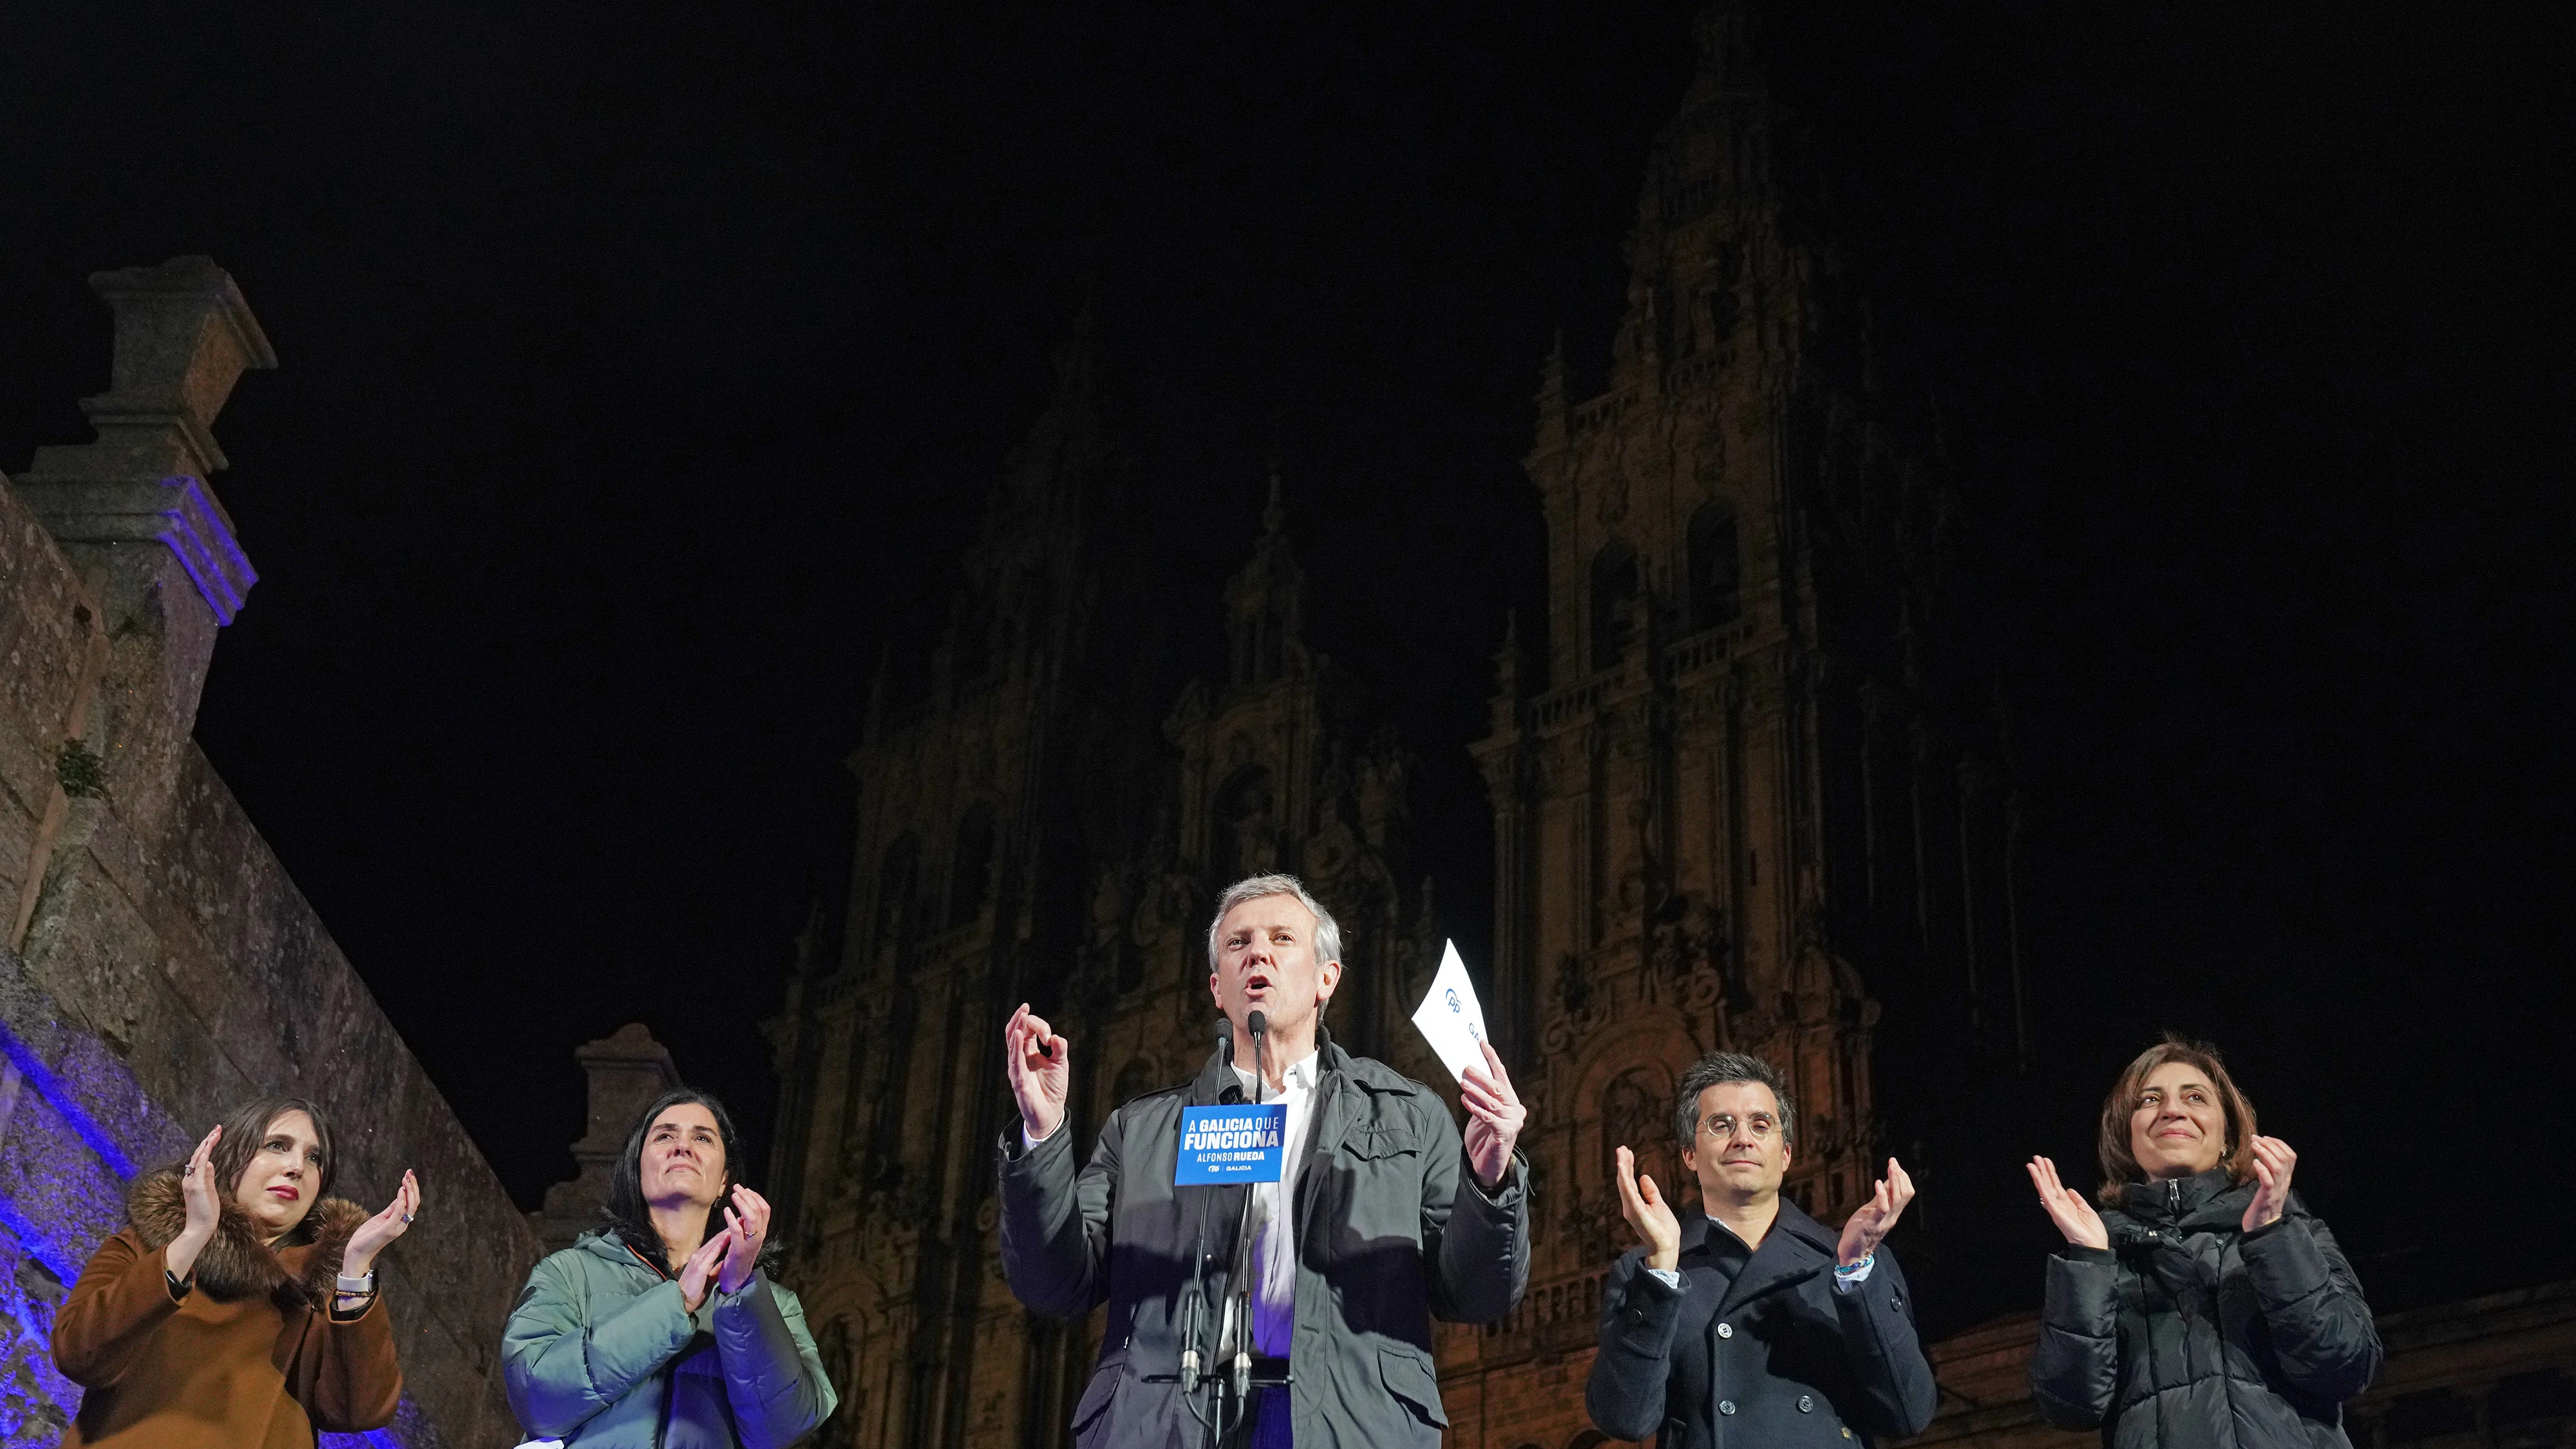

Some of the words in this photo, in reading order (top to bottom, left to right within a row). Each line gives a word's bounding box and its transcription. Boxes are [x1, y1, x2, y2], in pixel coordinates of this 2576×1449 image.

[1469, 1023, 1479, 1044] GA
[1188, 1120, 1196, 1133] A
[1199, 1118, 1253, 1133] GALICIA
[1255, 1117, 1280, 1132] QUE
[1184, 1131, 1279, 1151] FUNCIONA
[1197, 1152, 1233, 1162] ALFONSO
[1233, 1151, 1265, 1162] RUEDA
